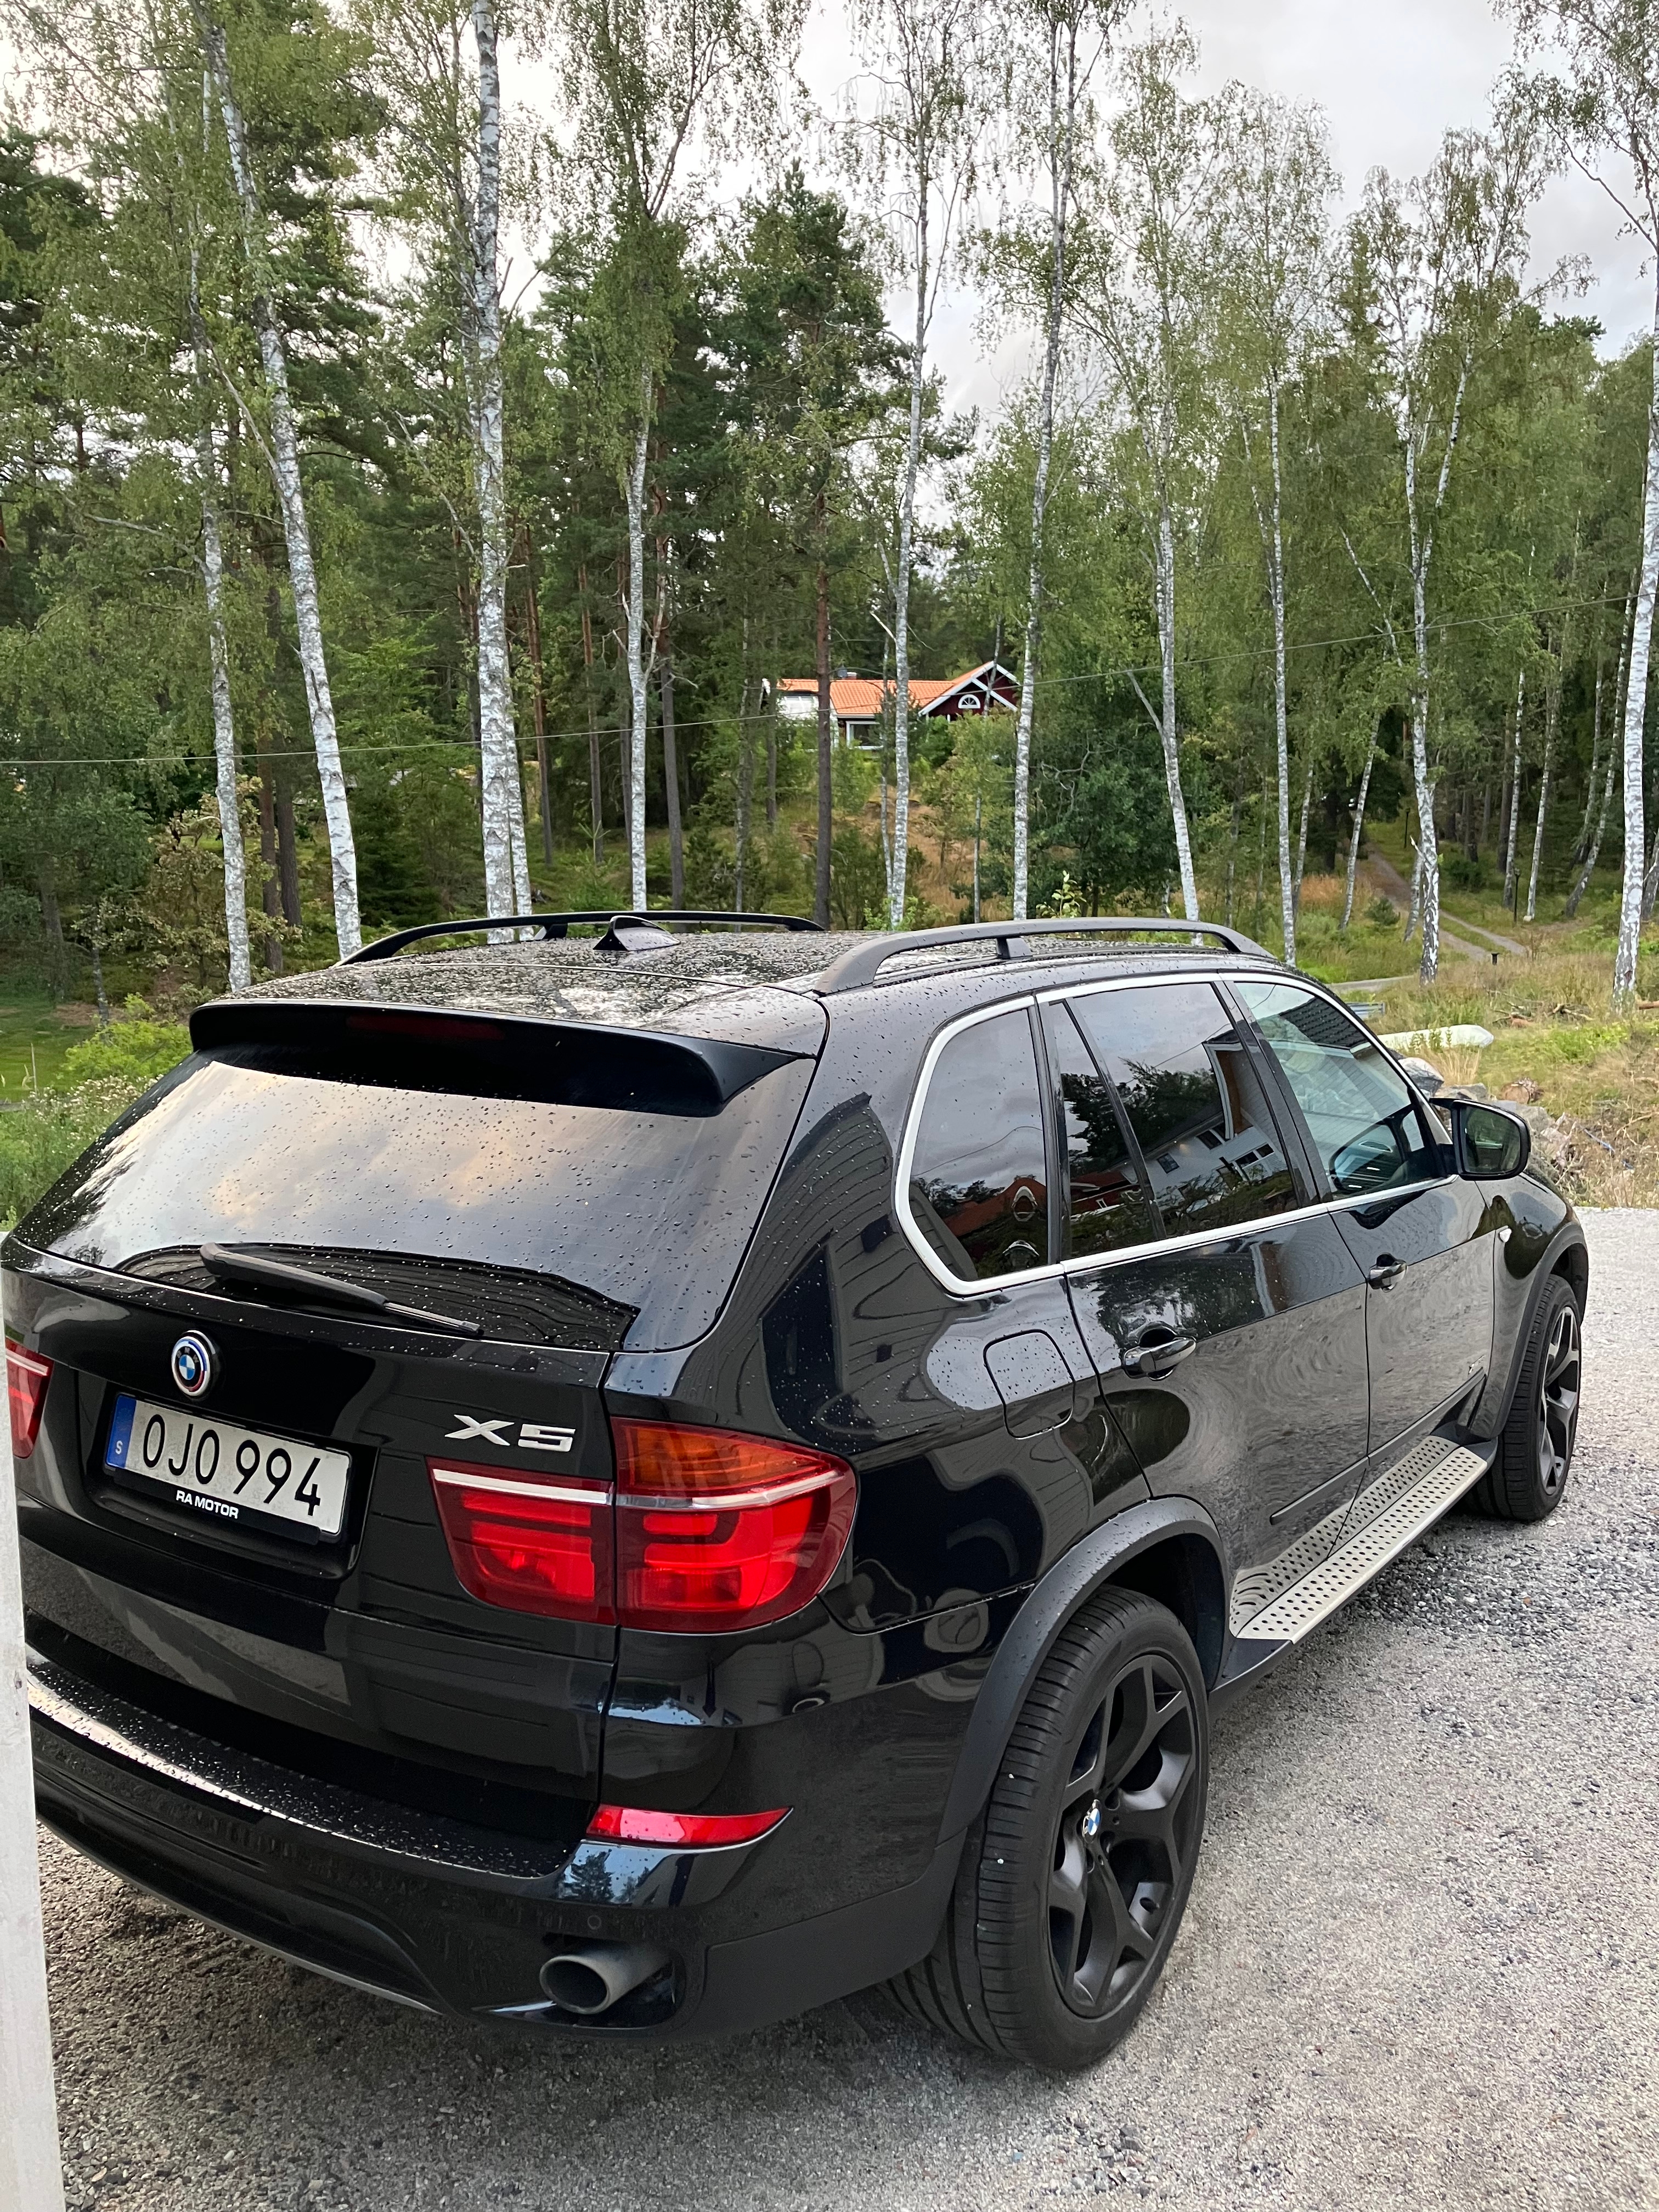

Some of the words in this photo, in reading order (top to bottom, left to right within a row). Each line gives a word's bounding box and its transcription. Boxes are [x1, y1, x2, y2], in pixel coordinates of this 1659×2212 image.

[115, 1440, 123, 1455] S
[444, 1414, 576, 1453] X5
[143, 1414, 220, 1485] OJO
[233, 1439, 321, 1517] 994
[176, 1489, 193, 1505] RA
[194, 1496, 239, 1519] MOTOR
